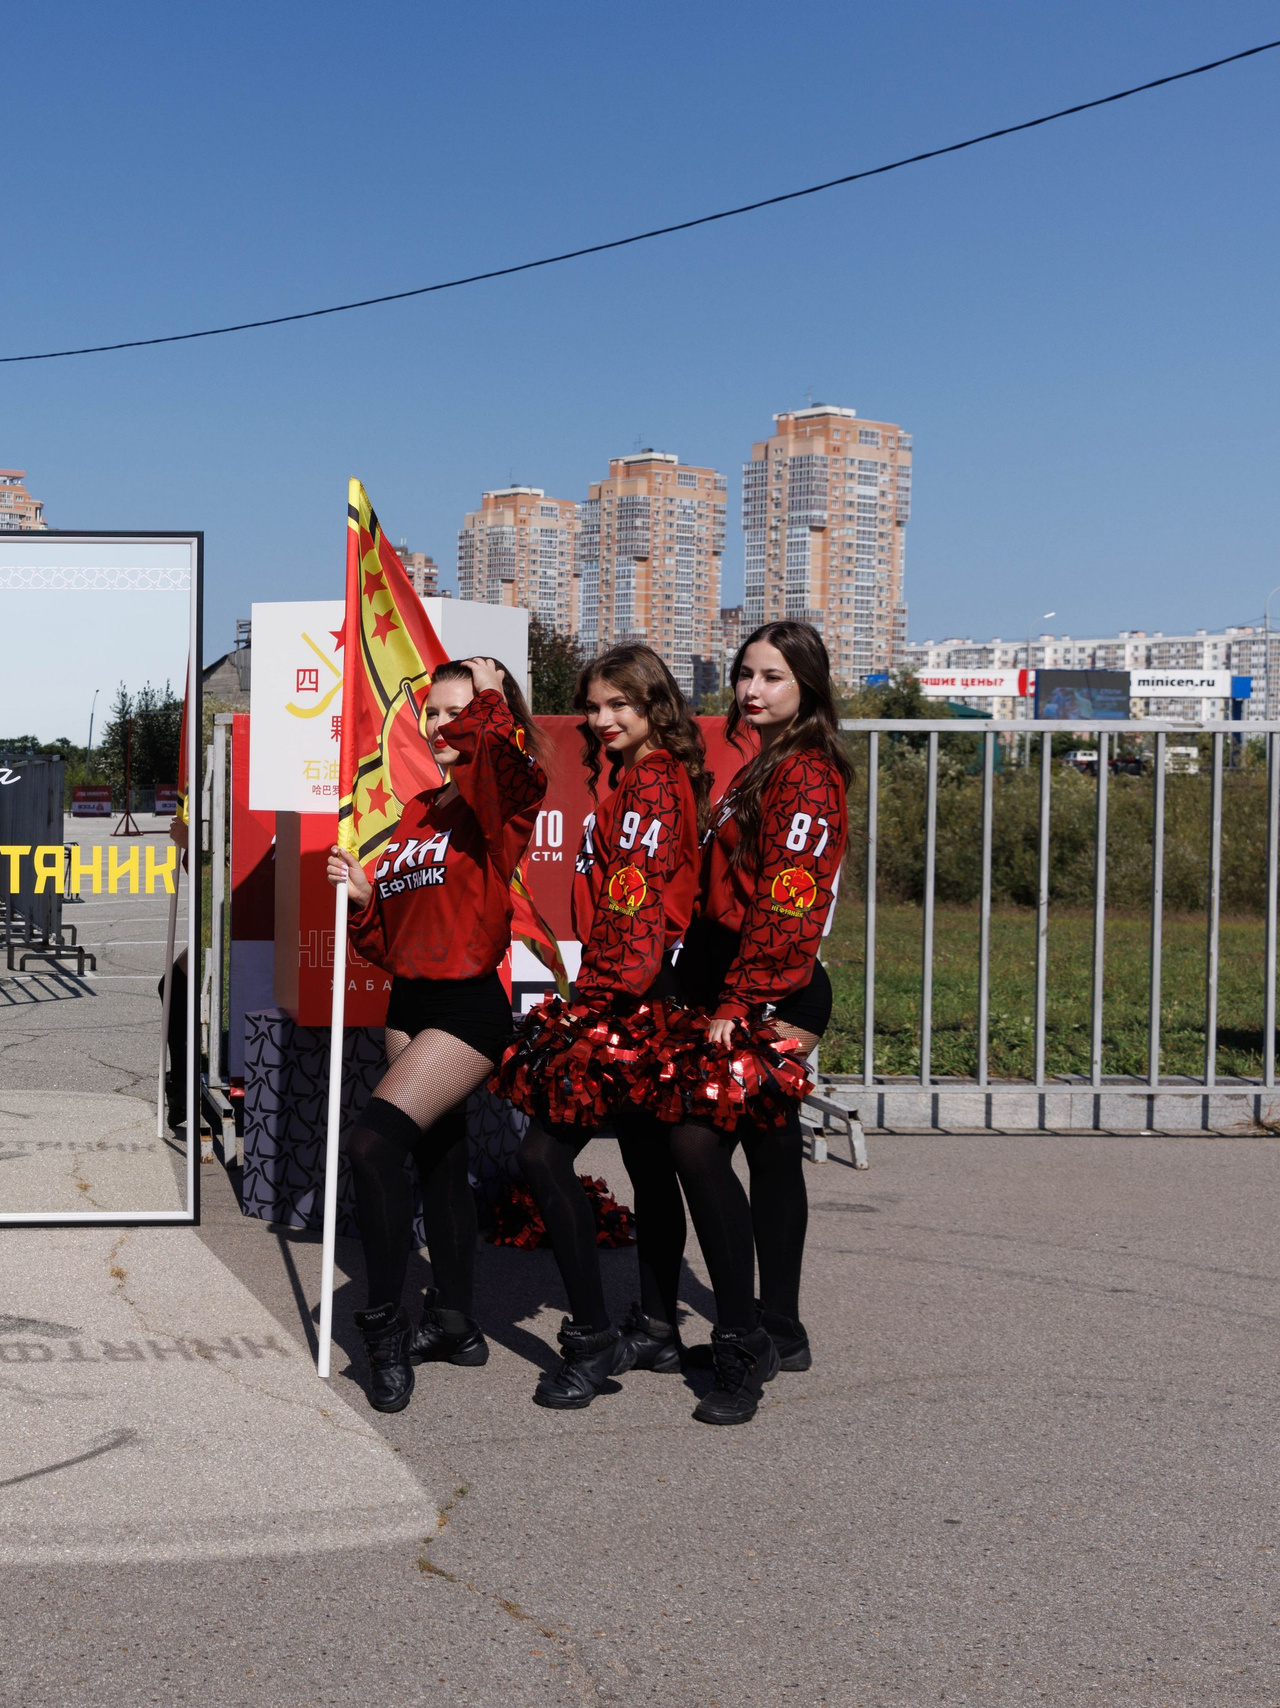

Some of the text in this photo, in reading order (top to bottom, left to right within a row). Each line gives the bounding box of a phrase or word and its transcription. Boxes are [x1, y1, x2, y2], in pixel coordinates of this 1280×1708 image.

[296, 669, 319, 693] 四
[919, 677, 1004, 687] ЧШИЕ ЦЕНЫ?
[1137, 676, 1215, 687] minicen.ru
[302, 760, 339, 780] 石油
[620, 811, 662, 858] 94
[786, 812, 829, 857] 87
[374, 829, 452, 880] СКА
[531, 851, 563, 861] СТИ
[379, 867, 446, 899] ЕФТЯНИК
[619, 874, 635, 906] СКА
[782, 875, 804, 908] СКА
